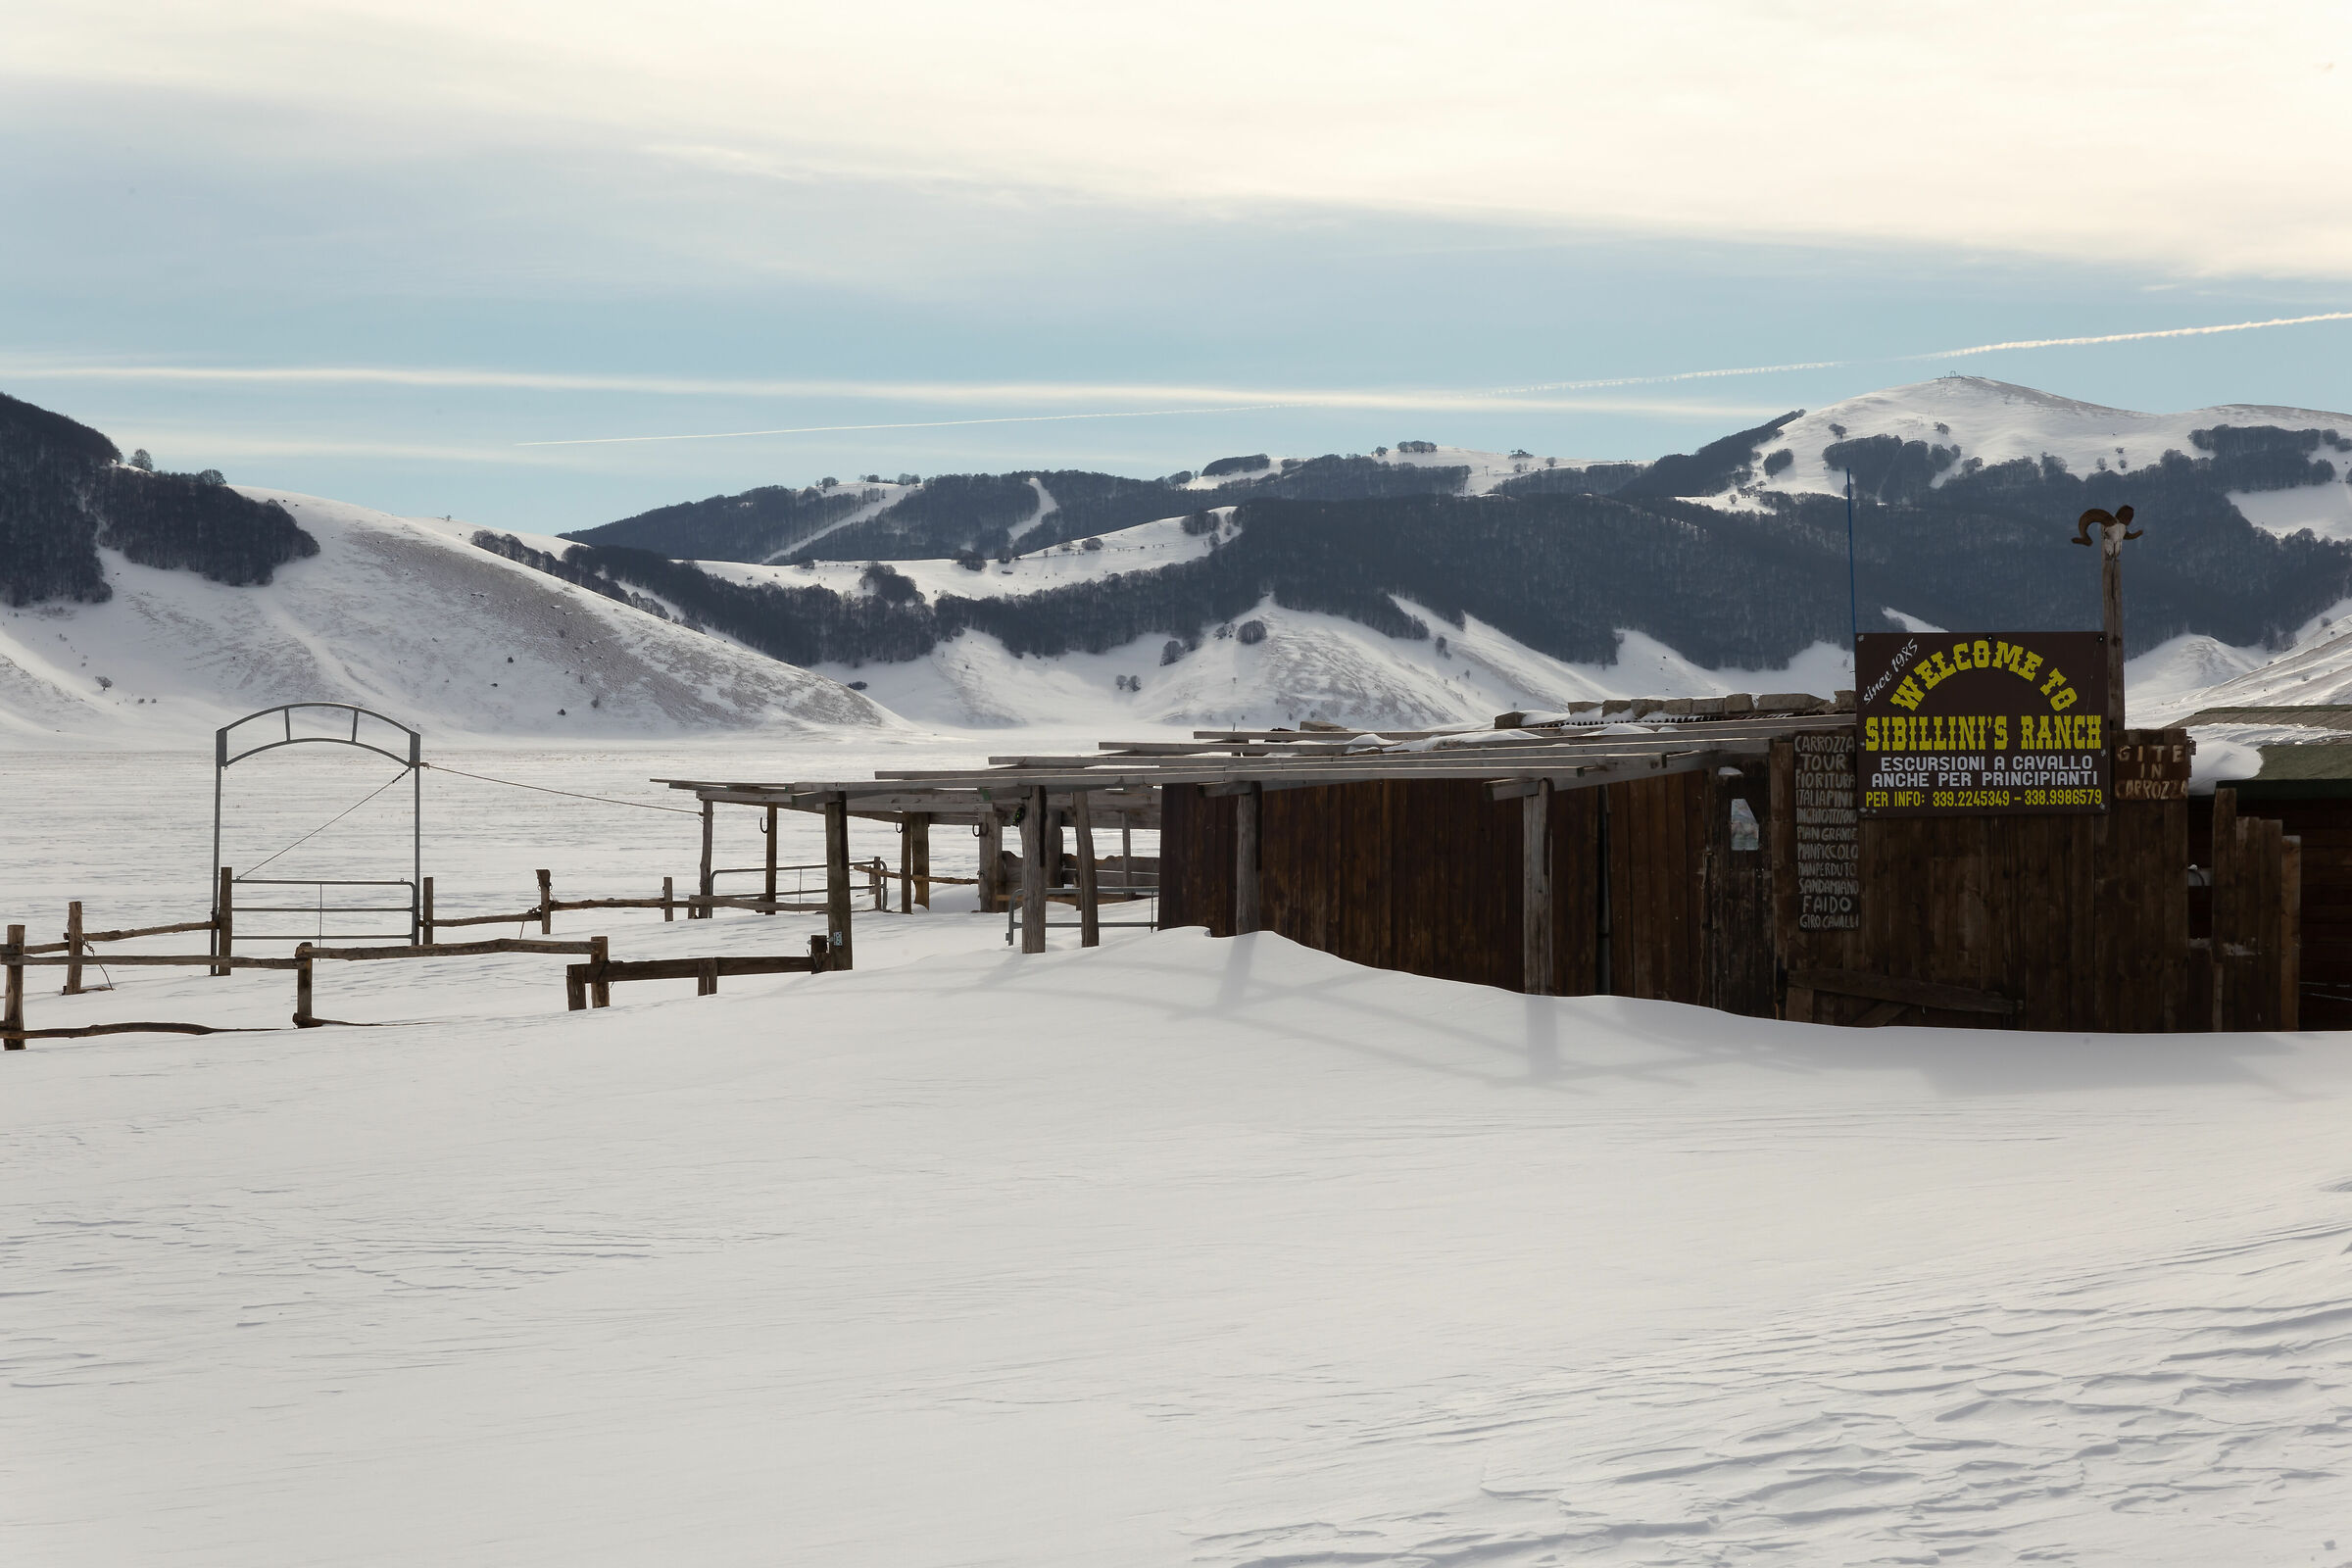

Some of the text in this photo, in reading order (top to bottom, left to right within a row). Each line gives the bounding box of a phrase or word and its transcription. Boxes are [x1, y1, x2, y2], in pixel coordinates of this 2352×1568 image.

[1863, 639, 1919, 705] since 1985
[1889, 640, 2078, 711] WELCOME TO
[1865, 715, 2102, 751] SIBILLINI'S RANCH
[1794, 736, 1855, 753] CARROZZA
[1800, 754, 1846, 770] TOUR
[2118, 745, 2183, 762] GITE
[1882, 756, 2092, 771] ESCURSIONI A CAVALLO
[2140, 763, 2163, 778] IN
[1795, 769, 1855, 789] FIORITURA
[1872, 771, 2097, 787] ANCHE PER PRINCIPIANTI
[1866, 792, 1888, 807] PER
[1894, 792, 1925, 807] INFO:
[1933, 791, 2009, 807] 339.2245349
[2025, 789, 2102, 805] 338.9986579
[1803, 896, 1851, 913] FAIDO
